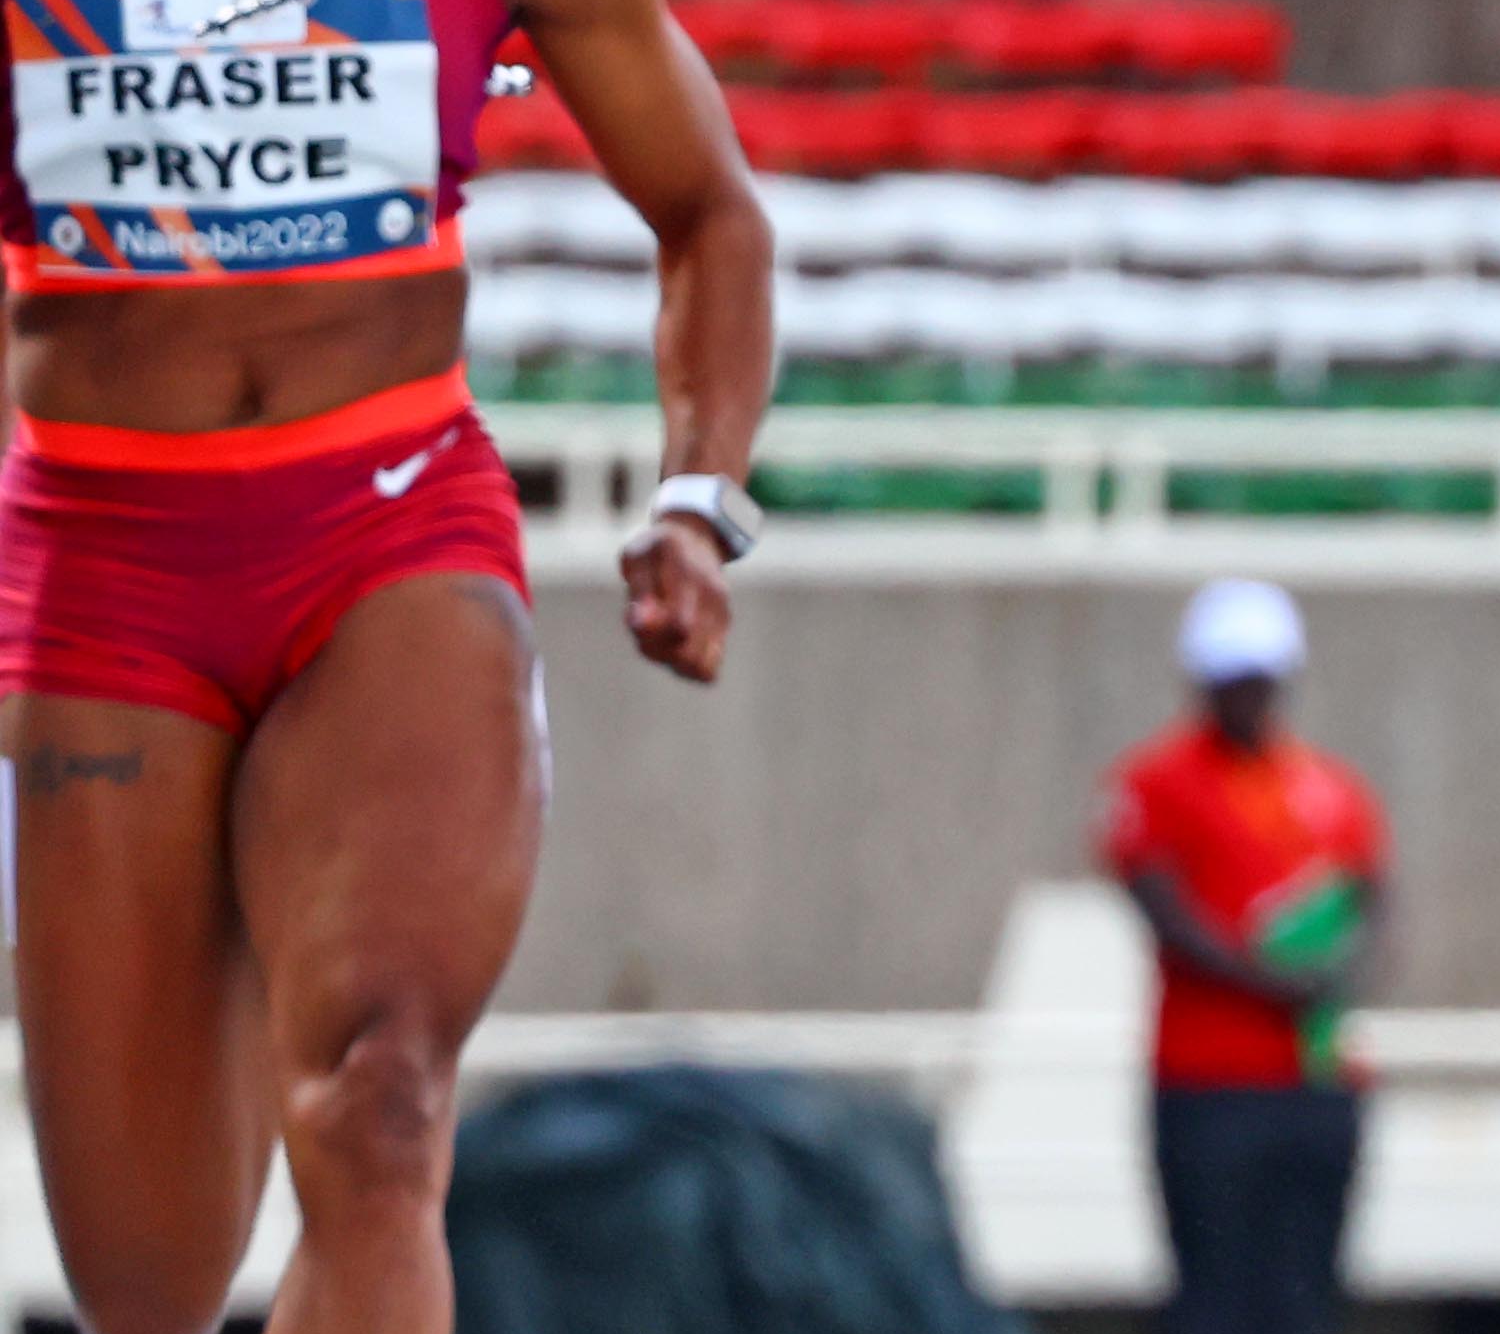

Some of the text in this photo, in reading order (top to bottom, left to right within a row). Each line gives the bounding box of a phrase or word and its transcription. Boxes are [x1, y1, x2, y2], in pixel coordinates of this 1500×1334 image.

[66, 54, 376, 117] FRASER
[106, 138, 350, 191] PRYCE
[113, 210, 349, 261] Nairobi2022
